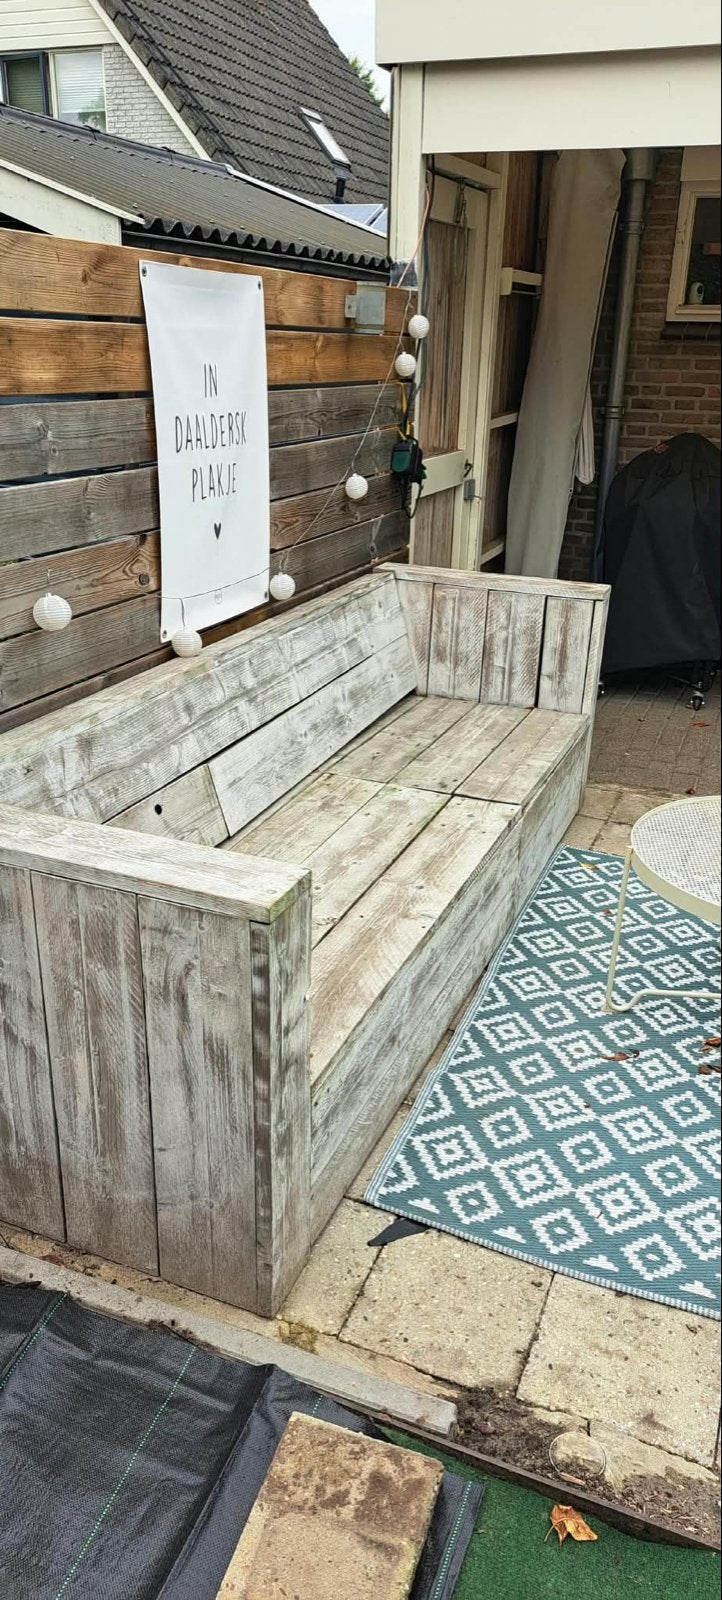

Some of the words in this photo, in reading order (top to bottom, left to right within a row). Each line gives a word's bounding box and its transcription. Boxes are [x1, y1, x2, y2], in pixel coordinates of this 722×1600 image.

[203, 363, 218, 398] IN
[175, 411, 247, 454] DAALDERSK
[192, 462, 237, 502] PLAKJE
